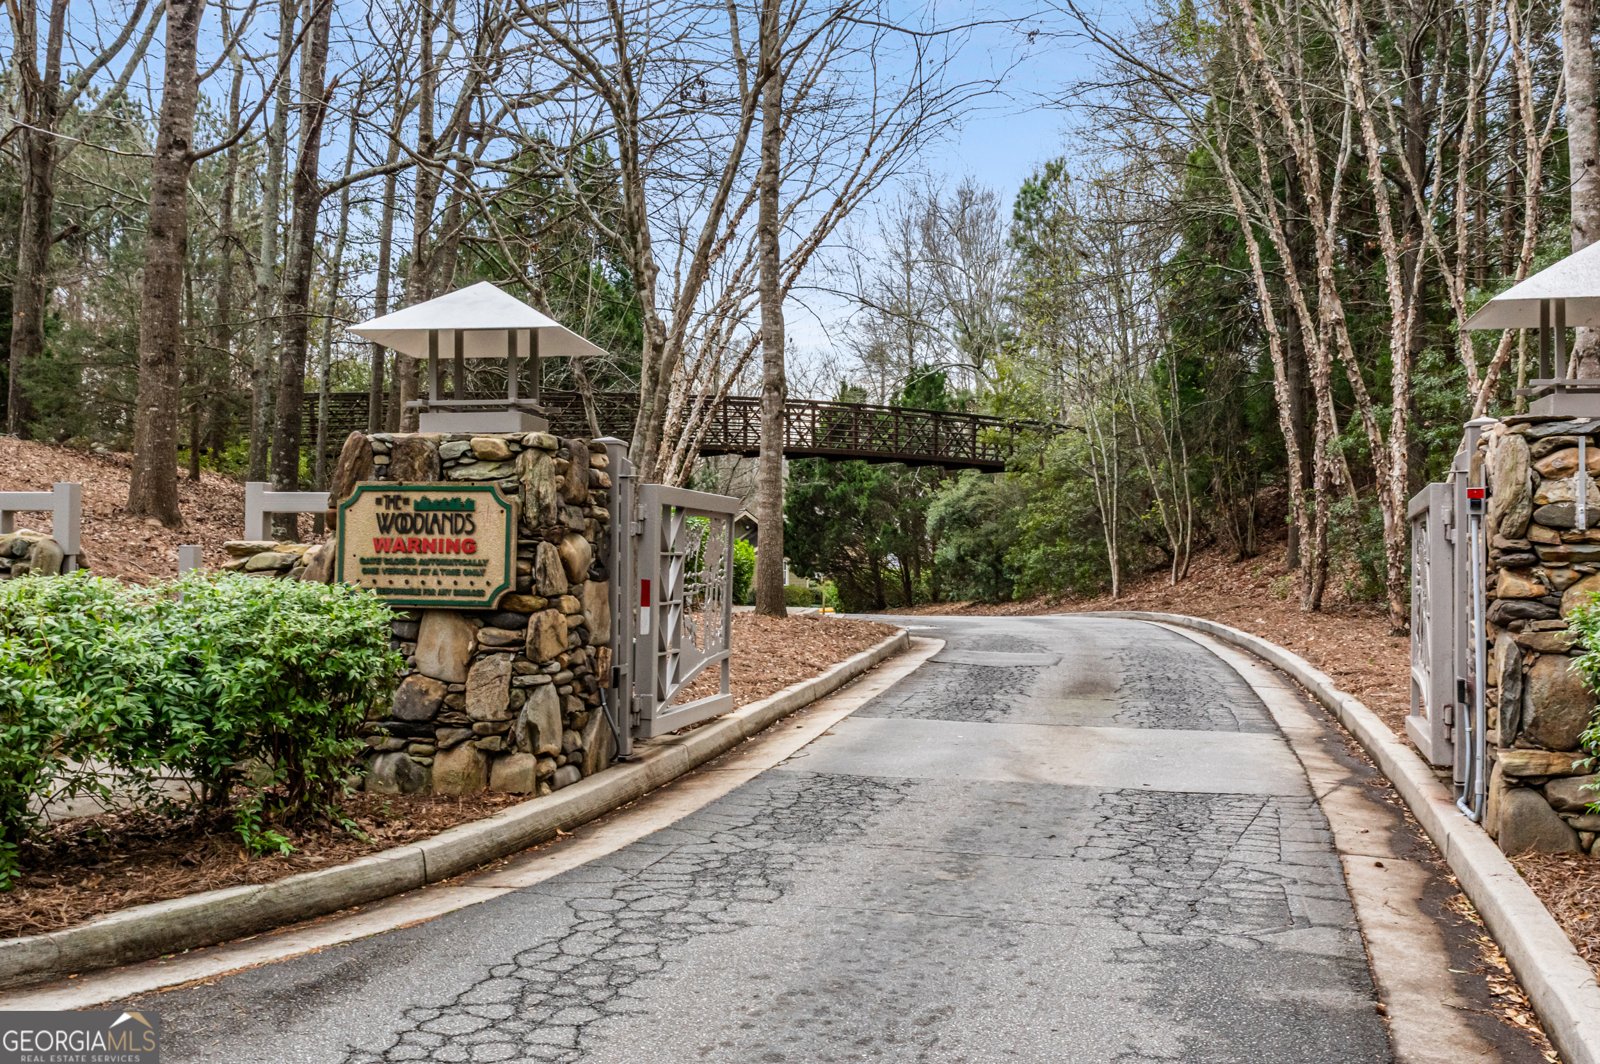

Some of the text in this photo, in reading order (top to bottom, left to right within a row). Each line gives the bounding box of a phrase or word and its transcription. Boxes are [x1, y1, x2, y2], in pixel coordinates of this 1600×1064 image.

[383, 495, 403, 511] THE
[376, 512, 477, 536] WOODLANDS
[373, 537, 477, 554] WARNING
[418, 557, 489, 567] AUTOMATICALLY
